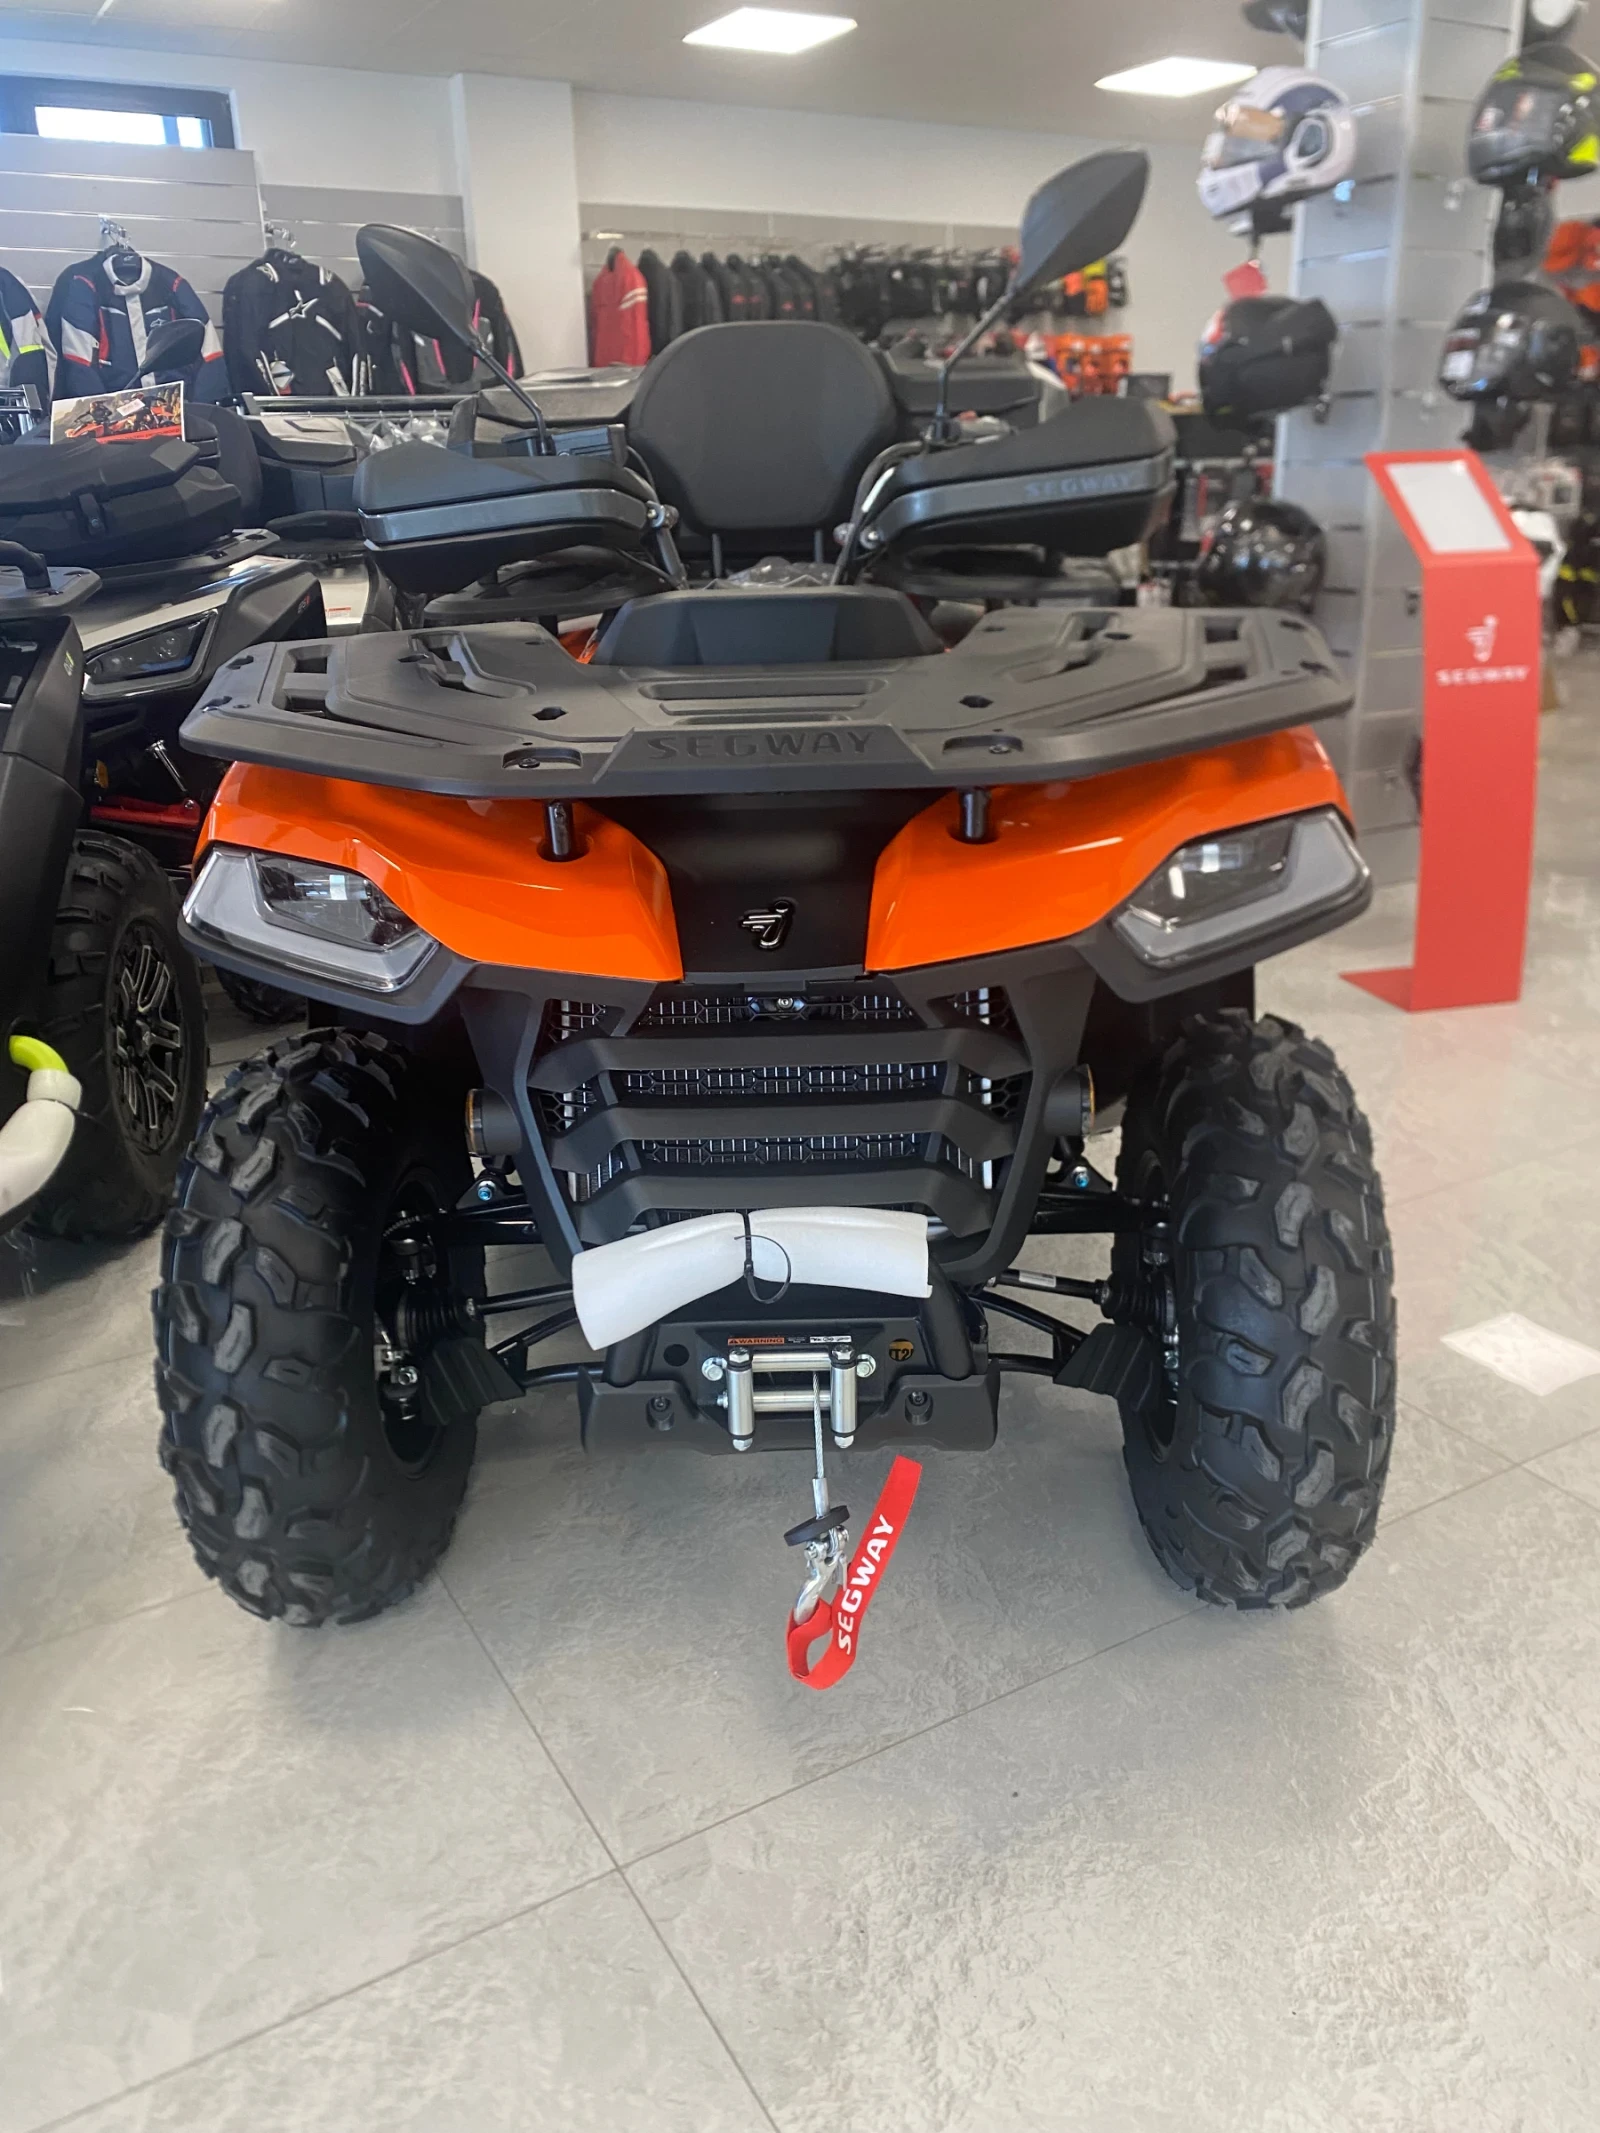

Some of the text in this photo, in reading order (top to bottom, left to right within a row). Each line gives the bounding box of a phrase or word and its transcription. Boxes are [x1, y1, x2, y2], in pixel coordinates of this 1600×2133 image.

[1024, 471, 1138, 497] SEGWAY
[1436, 666, 1530, 686] SEGWAY
[647, 731, 873, 759] SEGWAY
[838, 1514, 894, 1655] SEGWAY
